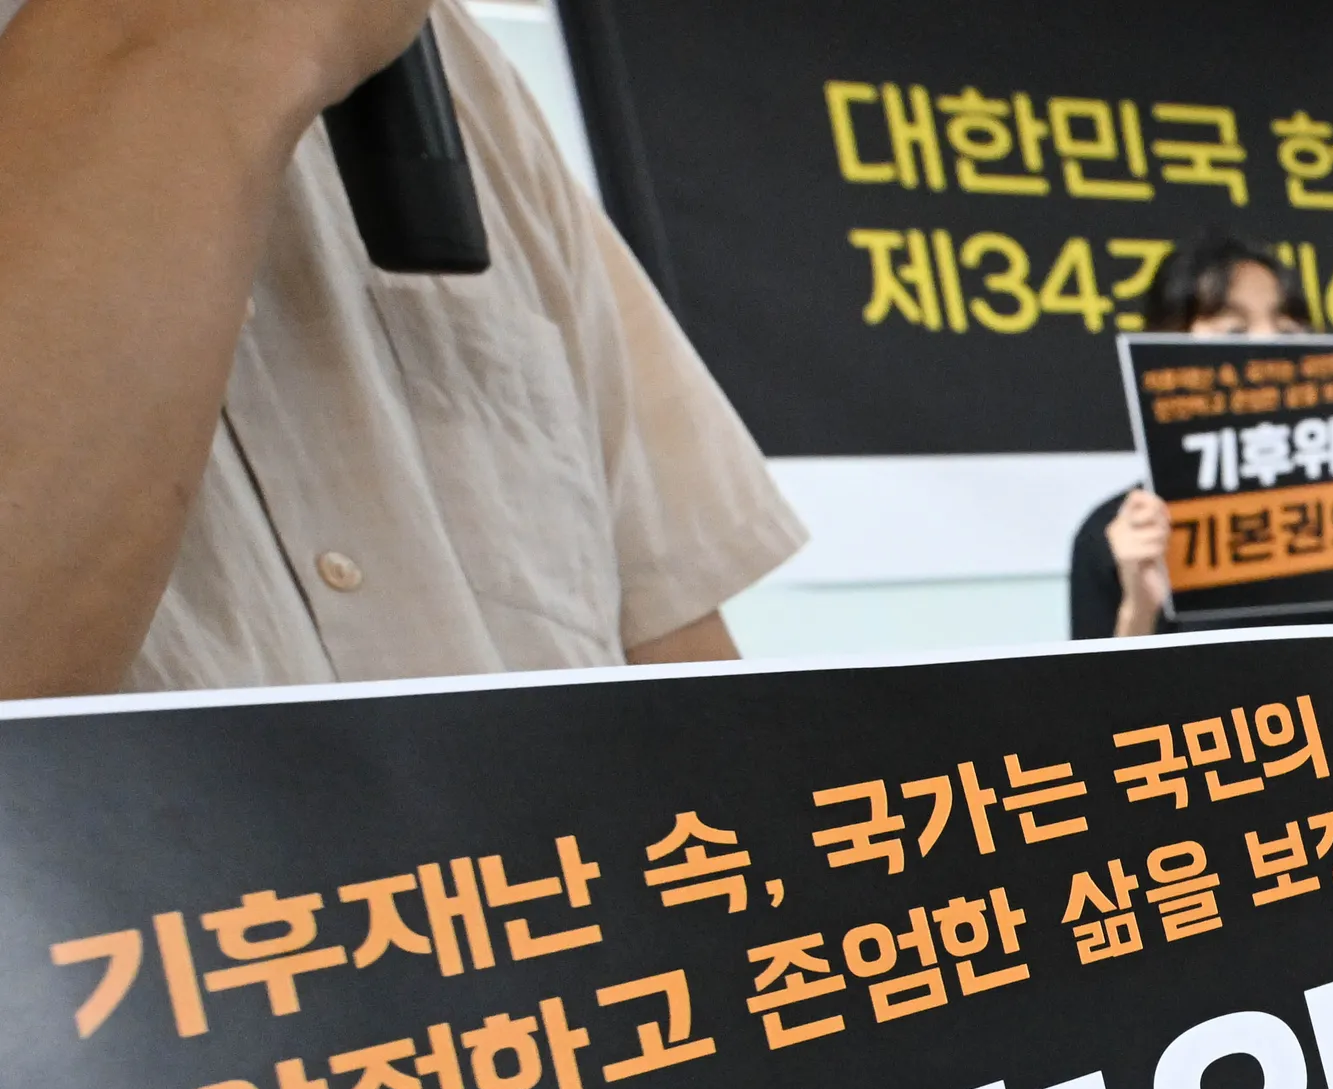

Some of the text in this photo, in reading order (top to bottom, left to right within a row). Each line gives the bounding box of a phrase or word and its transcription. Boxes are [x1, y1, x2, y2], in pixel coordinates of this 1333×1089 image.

[825, 79, 1248, 205] 대한민국
[49, 694, 1331, 1039] 기후재난 속, 국가는 국민의
[744, 885, 1031, 1052] 존엄한
[1061, 838, 1225, 967] 삶을
